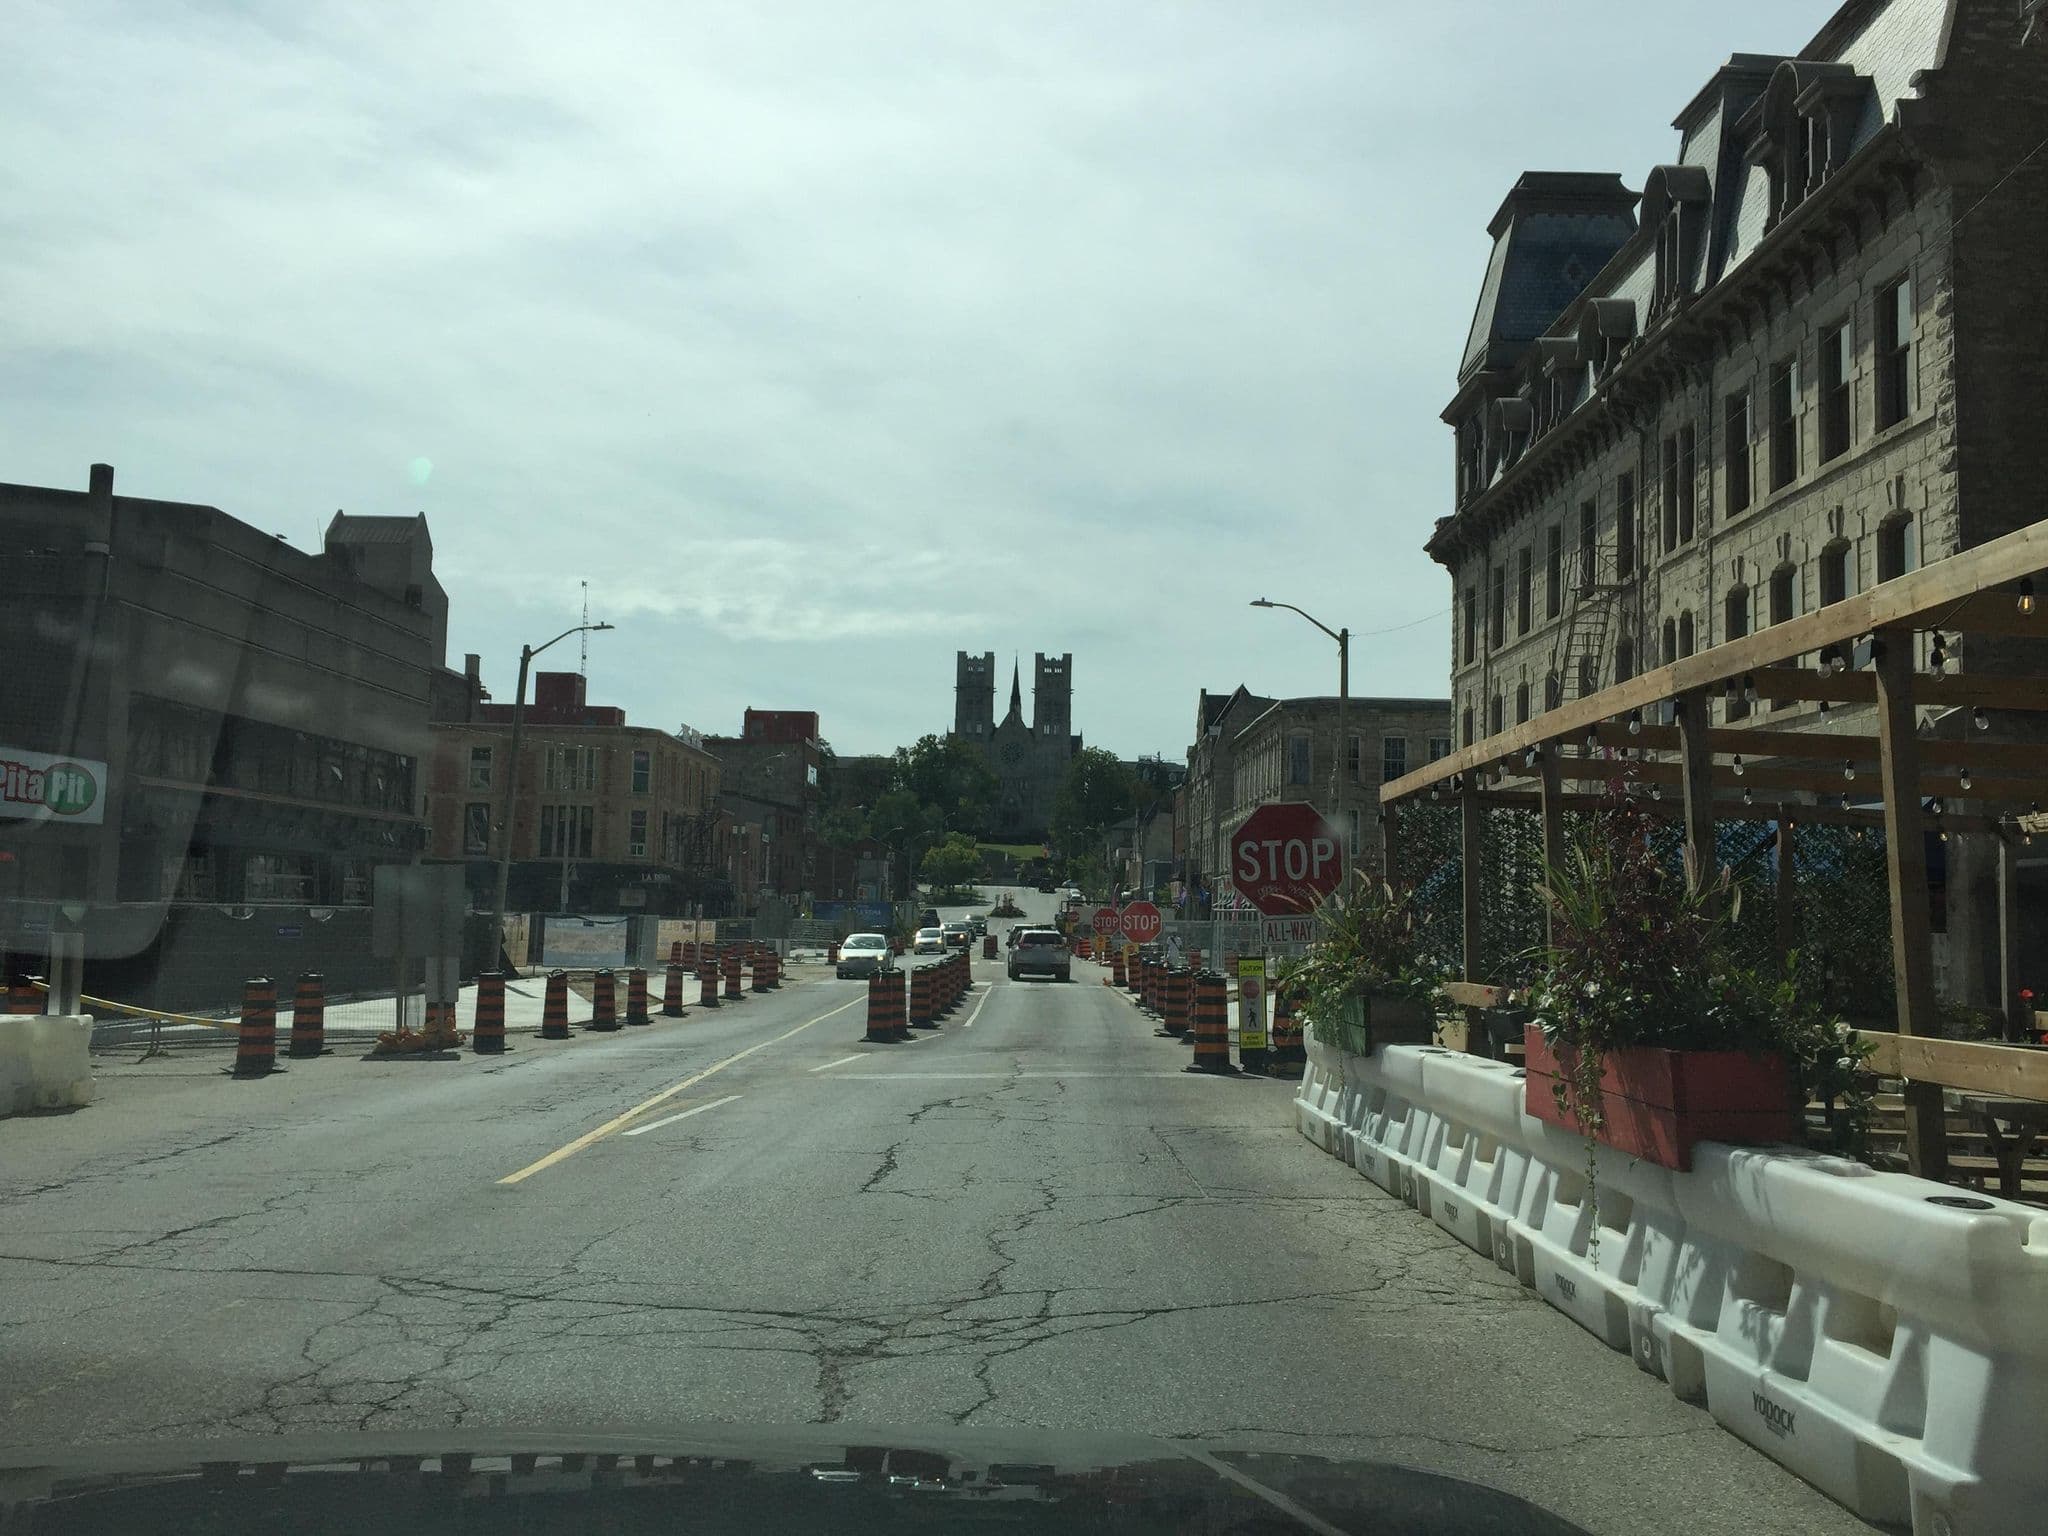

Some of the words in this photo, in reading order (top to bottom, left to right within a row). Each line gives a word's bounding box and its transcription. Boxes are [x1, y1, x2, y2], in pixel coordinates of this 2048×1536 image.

[51, 771, 86, 804] Pit
[1238, 838, 1335, 882] STOP
[1094, 915, 1119, 928] STOP
[1123, 915, 1159, 930] STOP
[1267, 921, 1312, 942] ALL-WAY
[1752, 1390, 1797, 1435] YODOCK
